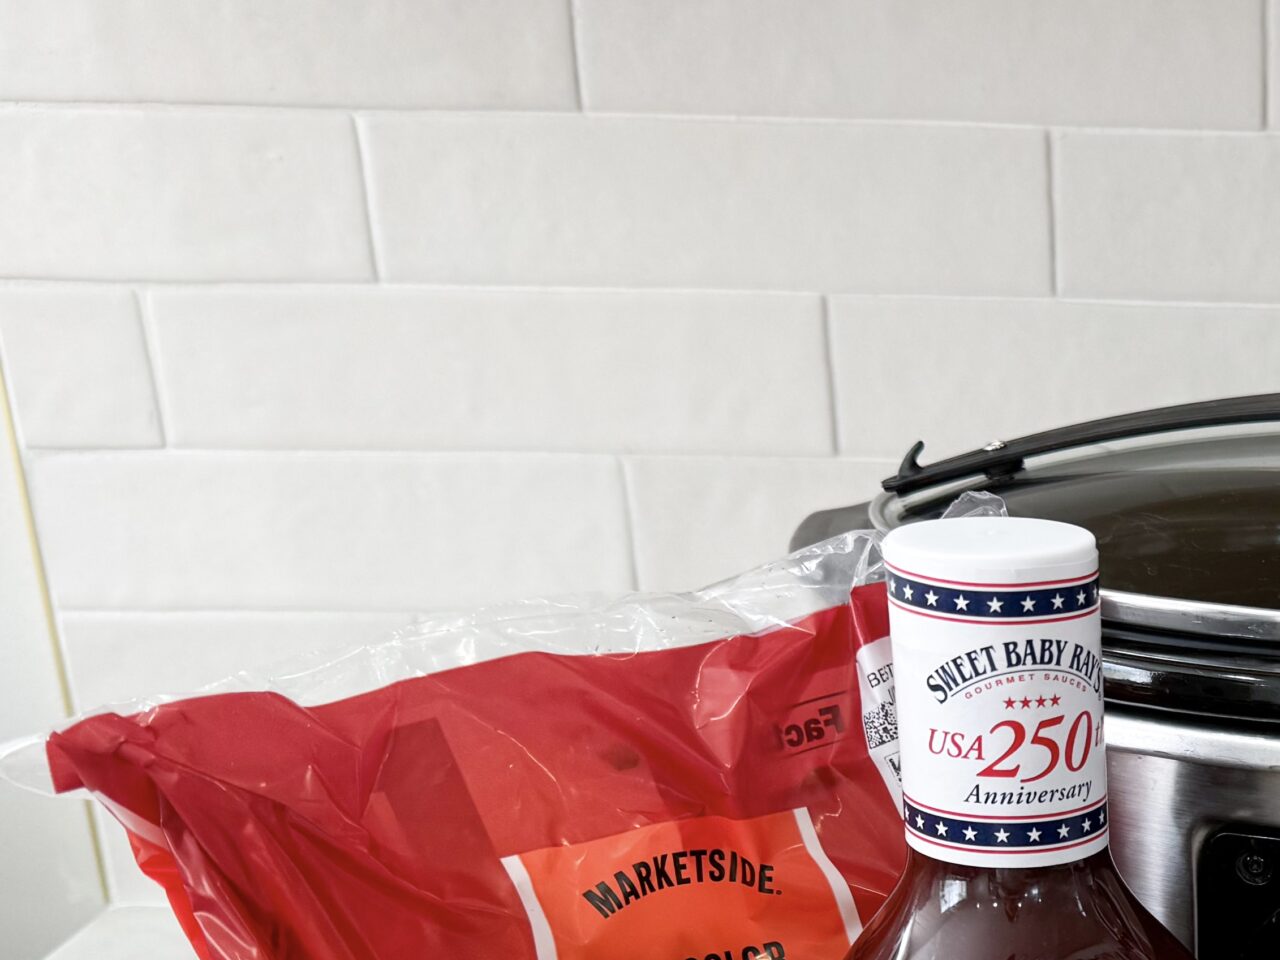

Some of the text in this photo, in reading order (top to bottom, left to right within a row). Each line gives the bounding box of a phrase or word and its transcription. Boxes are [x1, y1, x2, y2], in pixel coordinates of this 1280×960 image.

[926, 646, 996, 704] SWEET
[1002, 639, 1068, 666] BABY
[964, 673, 1087, 699] GOURMET SAUCES
[928, 728, 985, 760] USA
[964, 783, 1092, 804] Anniversary
